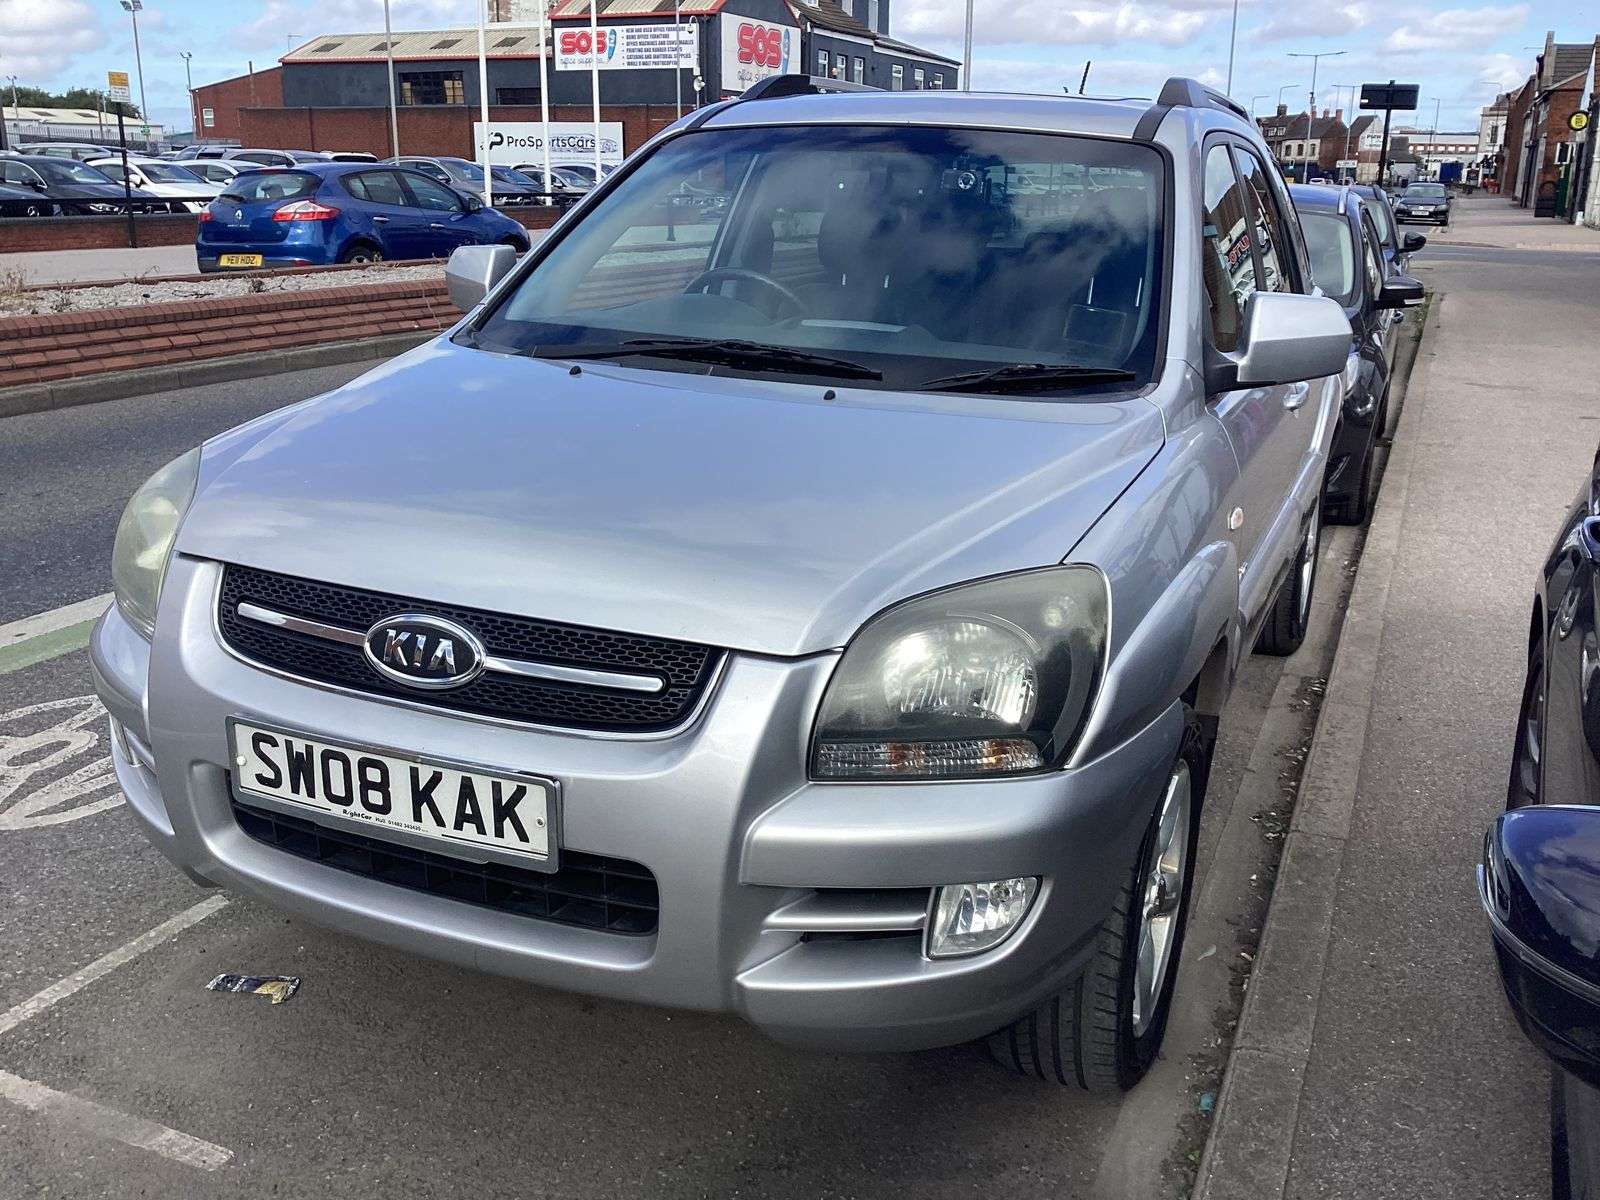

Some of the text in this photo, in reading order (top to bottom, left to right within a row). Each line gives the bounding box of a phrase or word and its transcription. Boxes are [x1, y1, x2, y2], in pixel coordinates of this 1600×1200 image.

[560, 31, 608, 56] SOS
[737, 22, 782, 69] SOS
[383, 628, 457, 675] KIA
[251, 731, 530, 843] SW08 KAK
